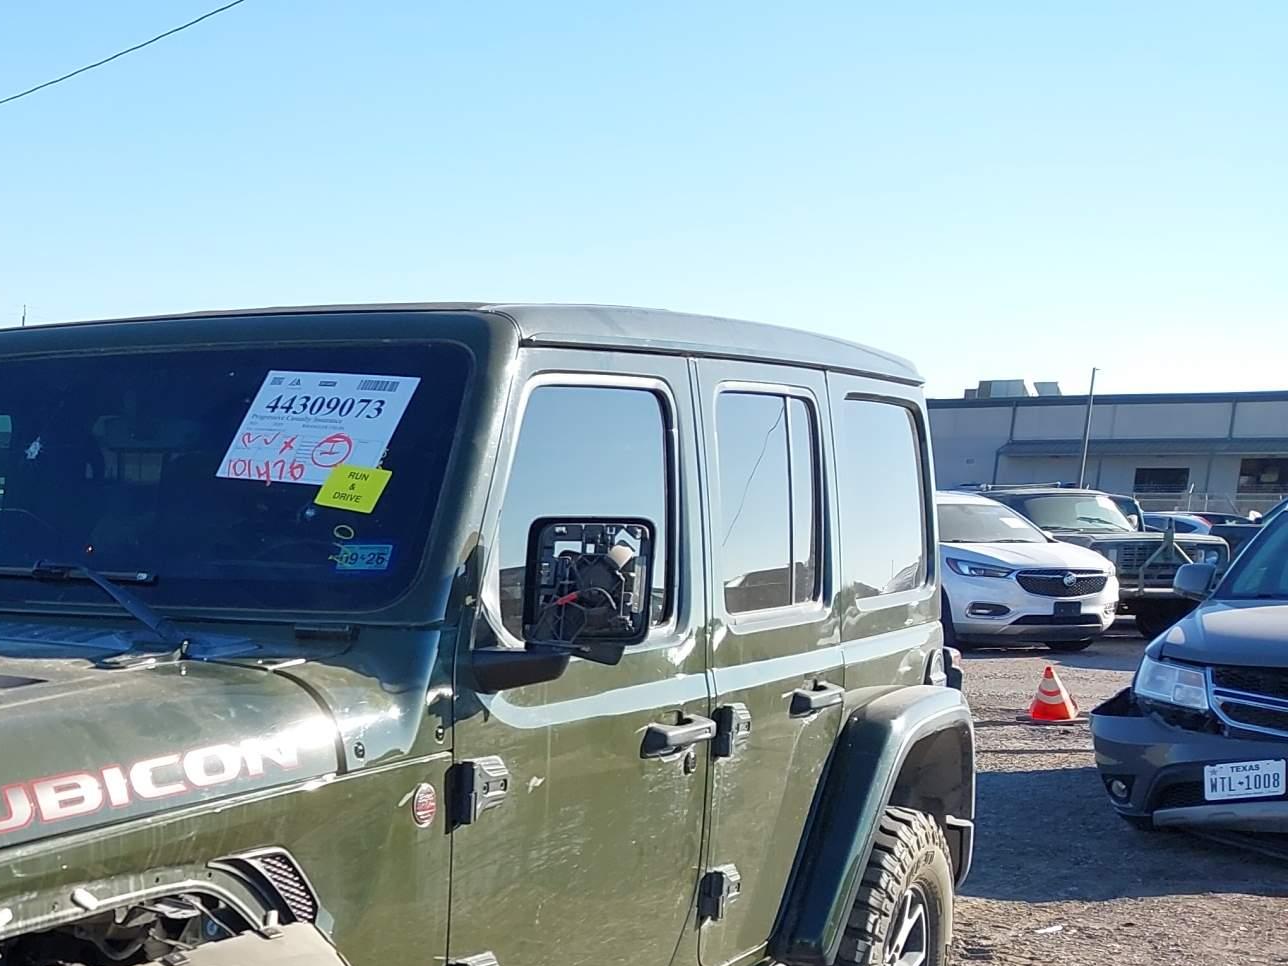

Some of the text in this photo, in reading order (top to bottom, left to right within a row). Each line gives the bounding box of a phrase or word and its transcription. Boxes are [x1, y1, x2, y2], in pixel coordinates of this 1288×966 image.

[266, 394, 386, 419] 44309073
[348, 471, 370, 481] RUN
[332, 491, 362, 503] DRIVE
[1230, 763, 1261, 773] TEXAS
